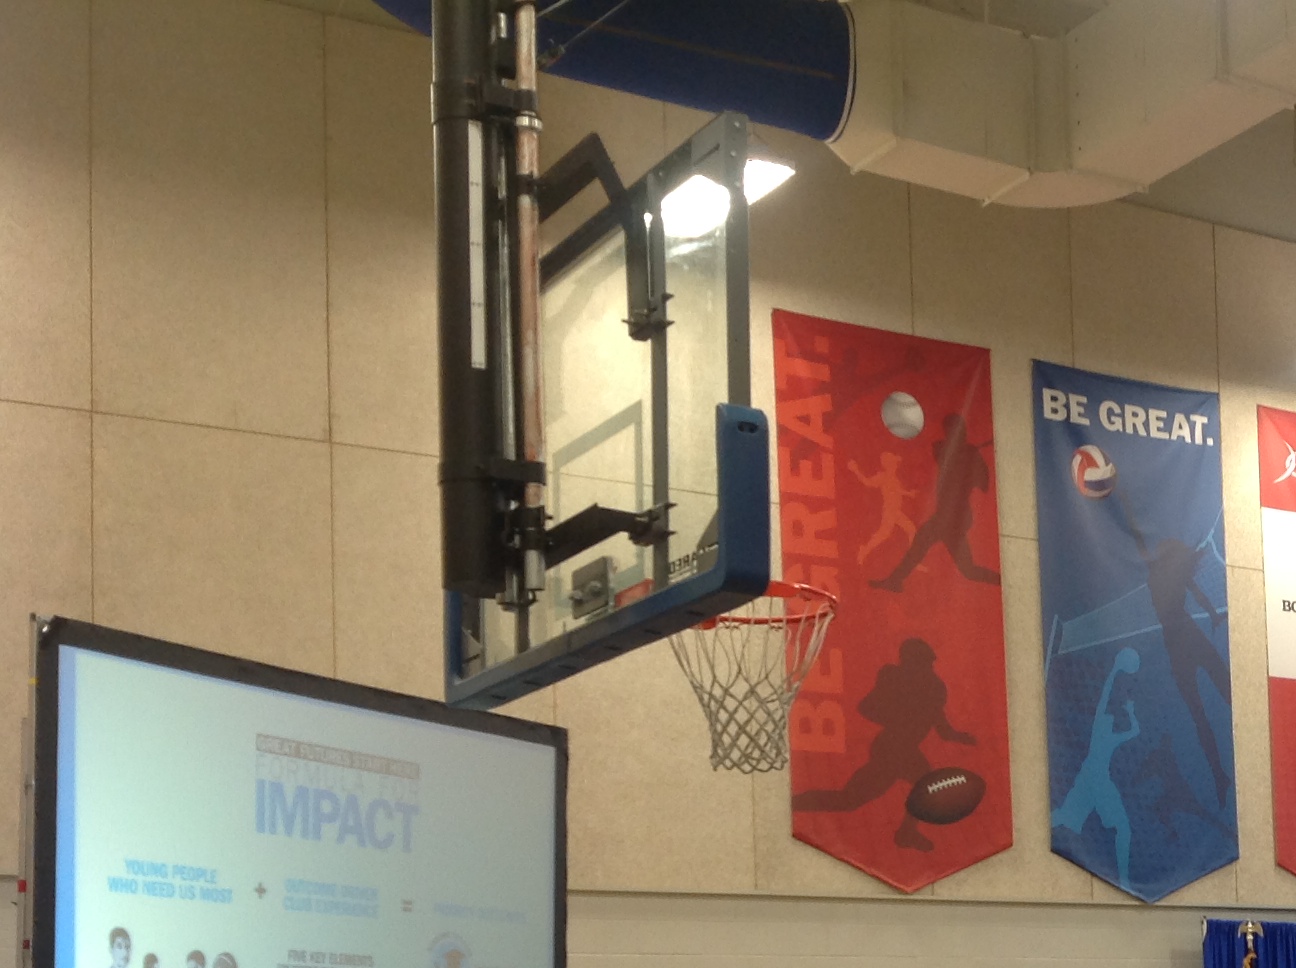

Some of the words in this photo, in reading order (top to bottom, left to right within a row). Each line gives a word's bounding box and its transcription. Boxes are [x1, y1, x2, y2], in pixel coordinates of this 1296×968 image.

[1042, 387, 1090, 426] BE
[1099, 400, 1213, 447] GREAT.
[256, 778, 420, 853] IMPACT
[125, 859, 169, 879] YOUNG
[173, 864, 217, 884] PEOPLE
[142, 880, 176, 898] NEED
[178, 885, 196, 900] US
